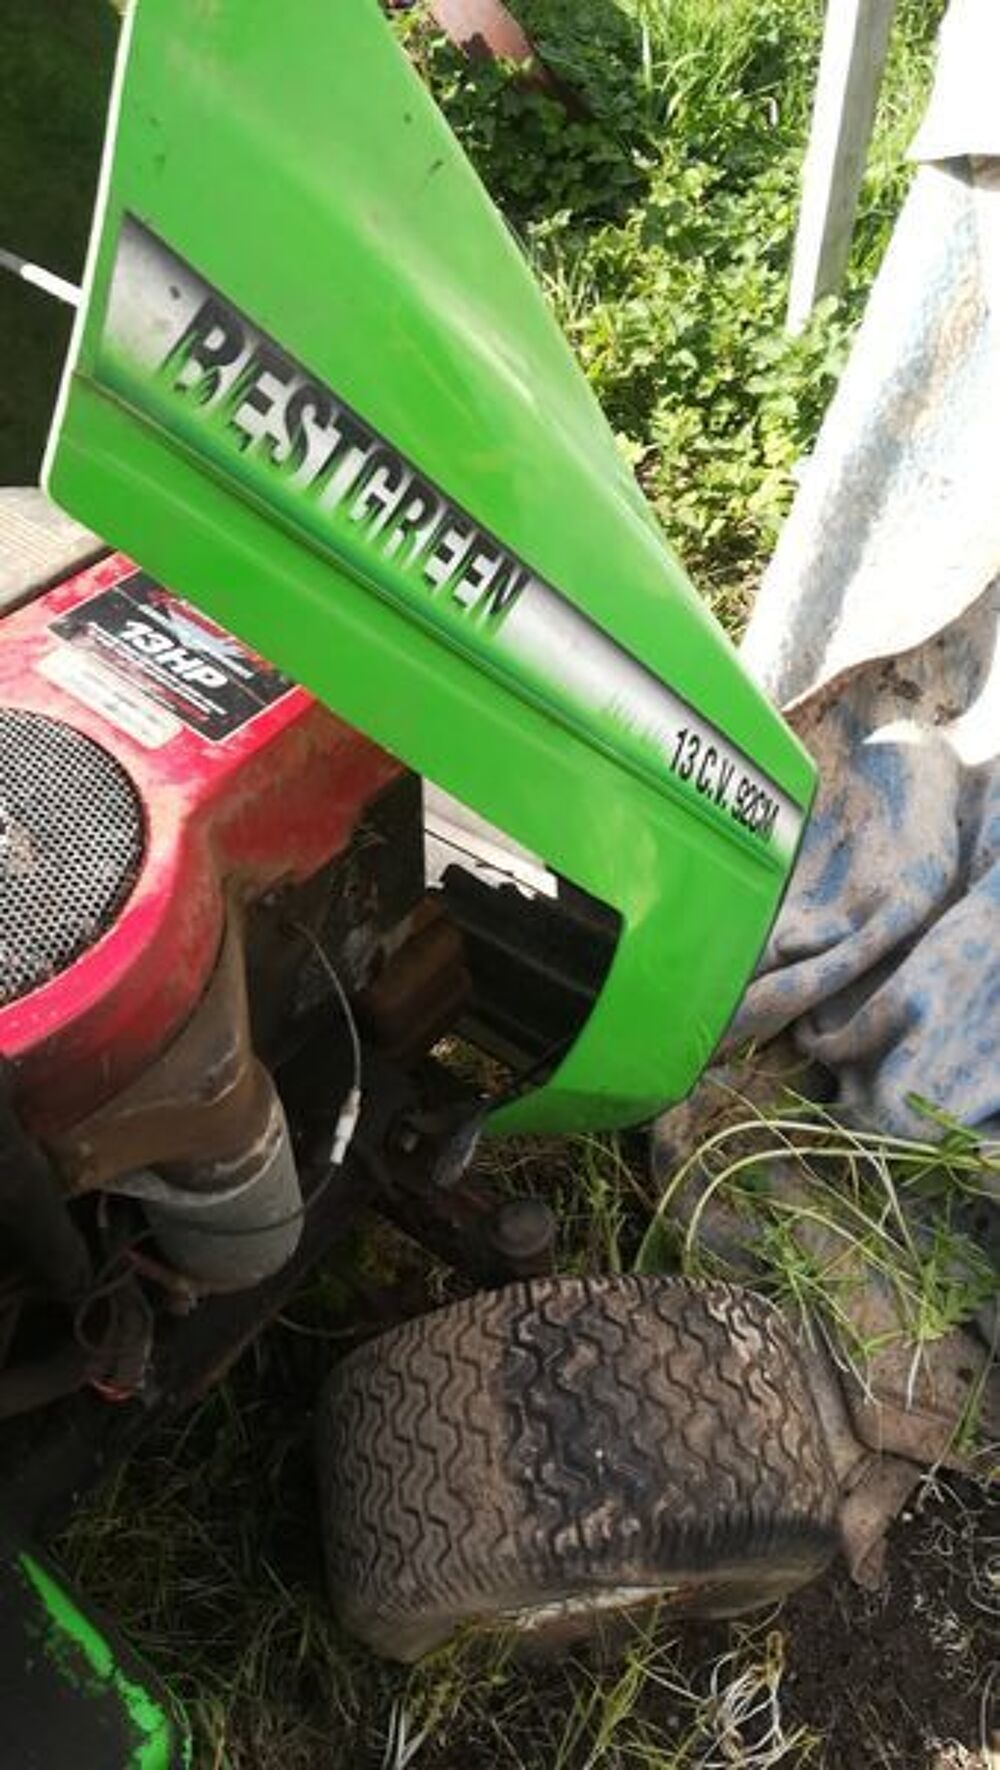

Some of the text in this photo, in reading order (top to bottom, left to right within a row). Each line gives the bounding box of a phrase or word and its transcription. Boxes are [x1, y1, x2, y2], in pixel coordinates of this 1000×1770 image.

[160, 298, 530, 630] BESTGREEN
[670, 728, 700, 781] 13
[696, 747, 734, 809] C.V.
